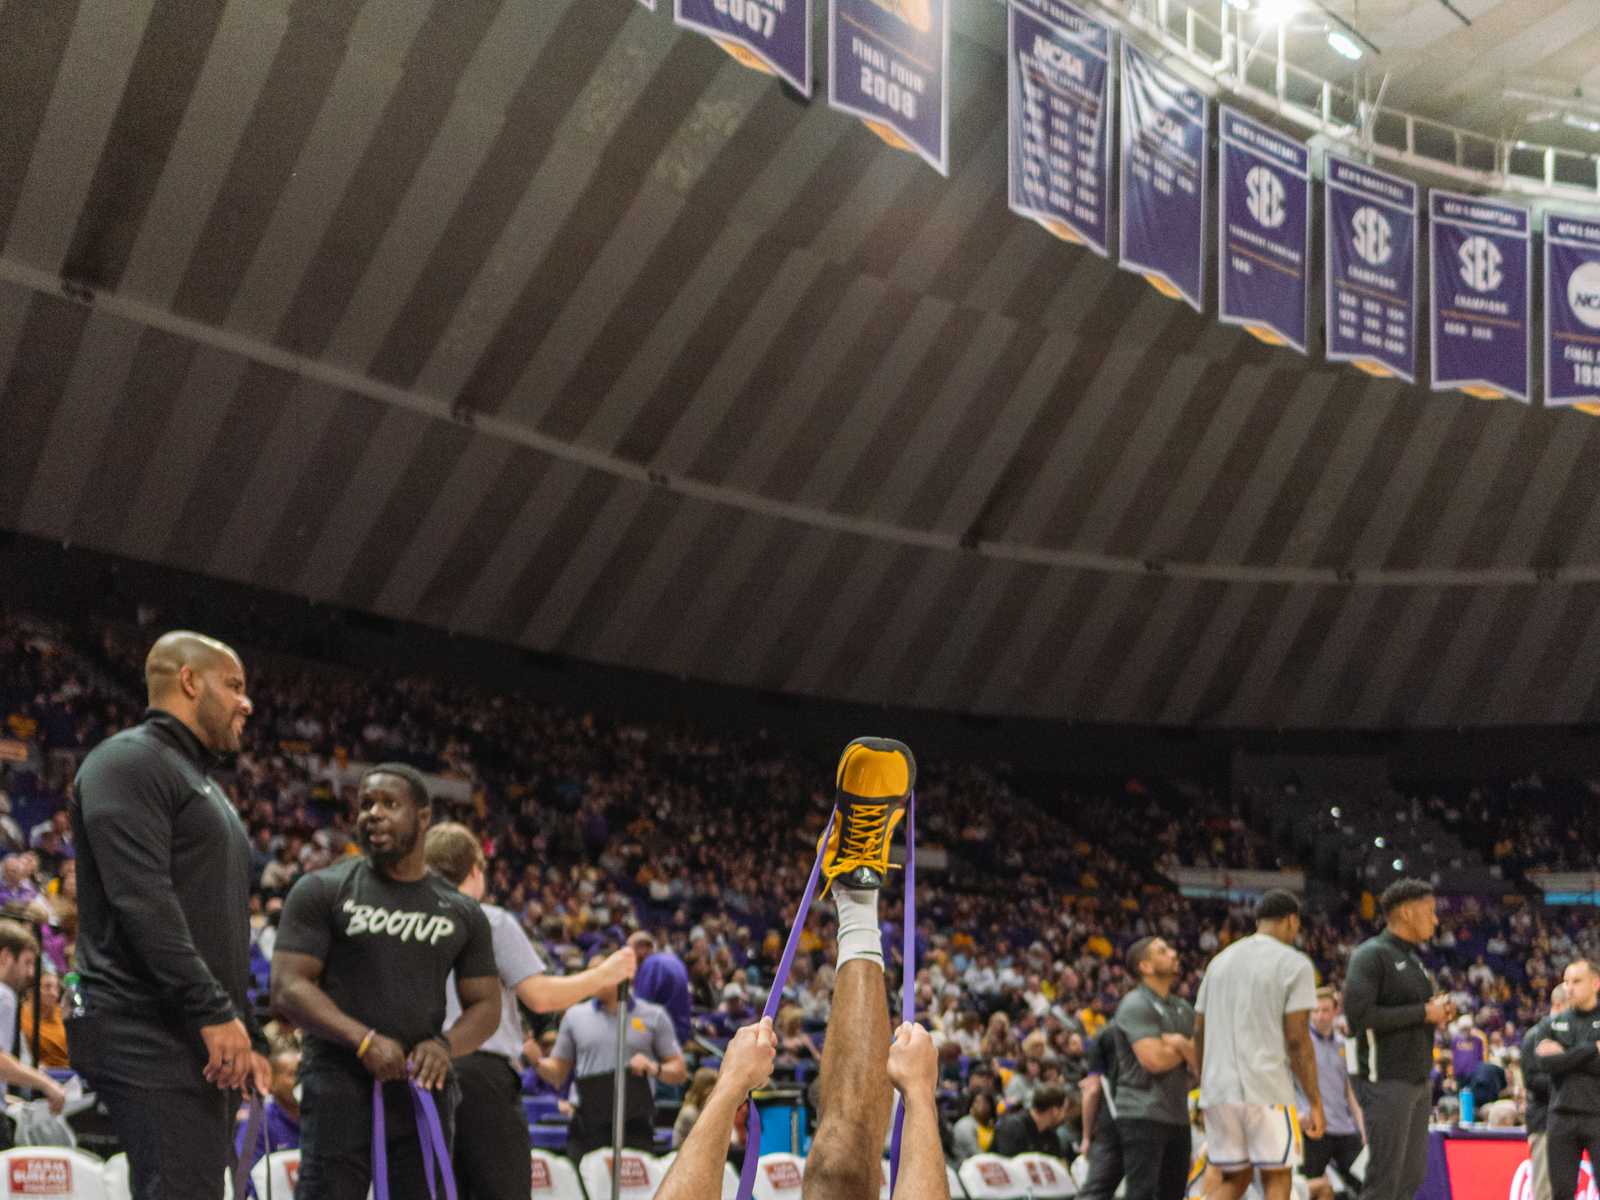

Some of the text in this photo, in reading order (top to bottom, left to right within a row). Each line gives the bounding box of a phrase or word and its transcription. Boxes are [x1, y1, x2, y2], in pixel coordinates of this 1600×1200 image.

[1245, 166, 1287, 228] SEC
[1351, 206, 1392, 265] SEC
[1458, 235, 1504, 291] SEC
